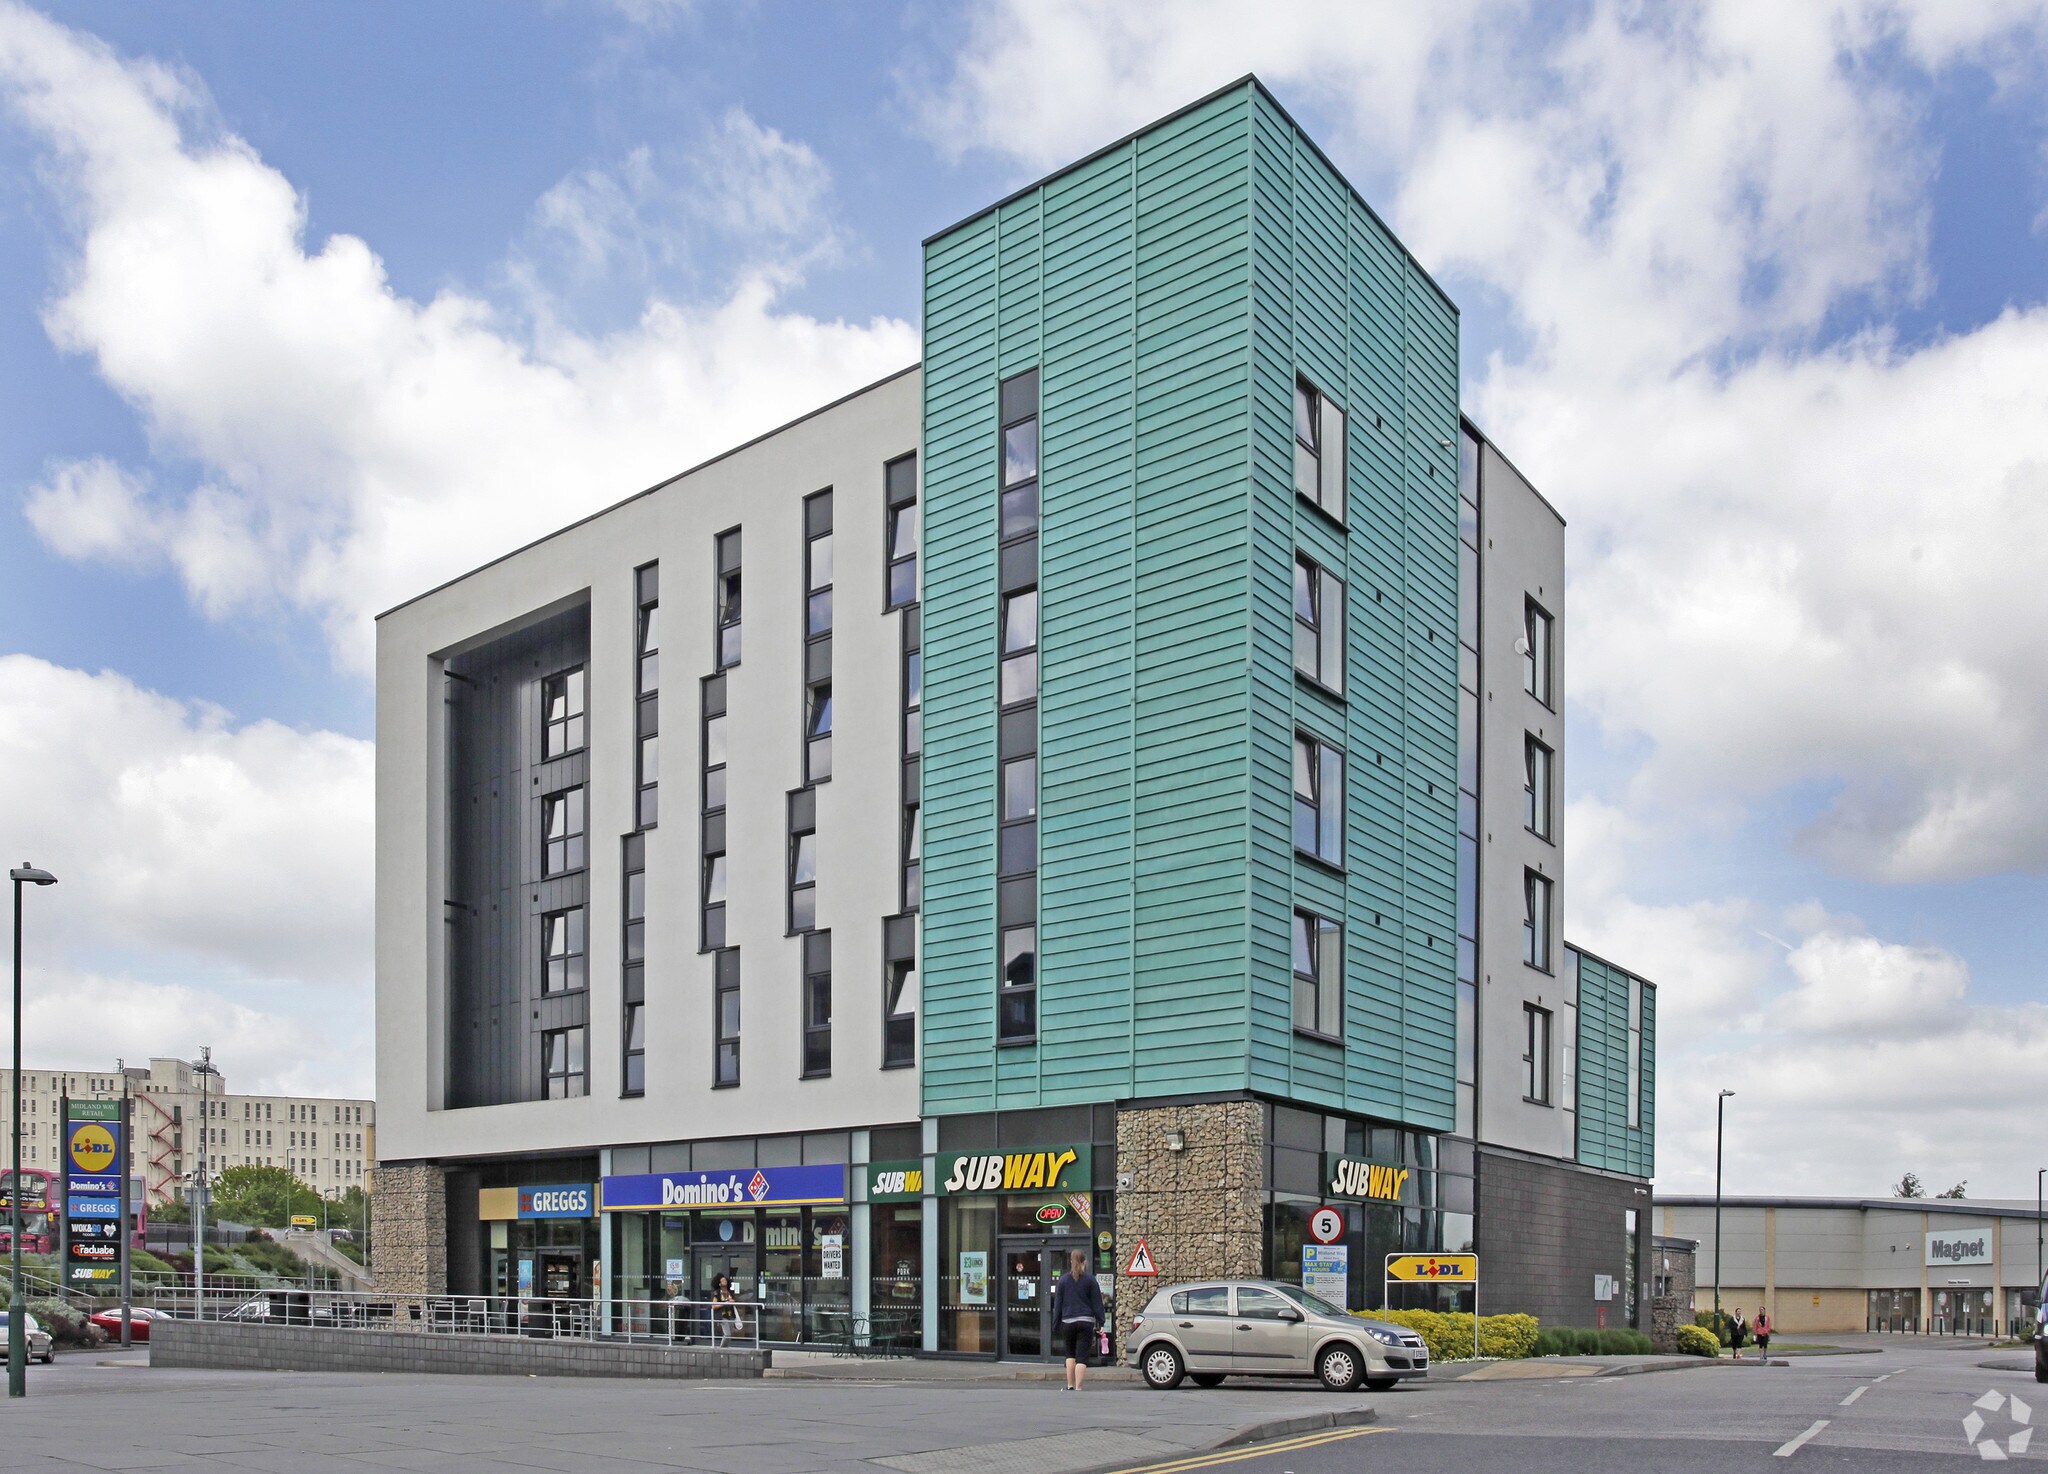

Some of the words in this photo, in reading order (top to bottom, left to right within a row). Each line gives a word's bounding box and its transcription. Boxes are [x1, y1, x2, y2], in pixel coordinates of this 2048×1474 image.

[944, 1148, 1077, 1192] SUBWAY
[1331, 1159, 1409, 1200] SUBWAY
[70, 1181, 106, 1190] Domino's
[662, 1174, 743, 1204] Domino's
[533, 1190, 587, 1211] GREGGS
[80, 1203, 116, 1212] GREGGS
[1039, 1208, 1062, 1219] OPEN
[1321, 1218, 1332, 1234] 5
[72, 1244, 115, 1256] Graduate
[823, 1251, 841, 1259] DRIVERS
[1932, 1238, 1984, 1261] Magnet
[823, 1261, 841, 1269] WANTED
[72, 1268, 116, 1279] SUBWAY
[897, 1268, 910, 1276] PORK
